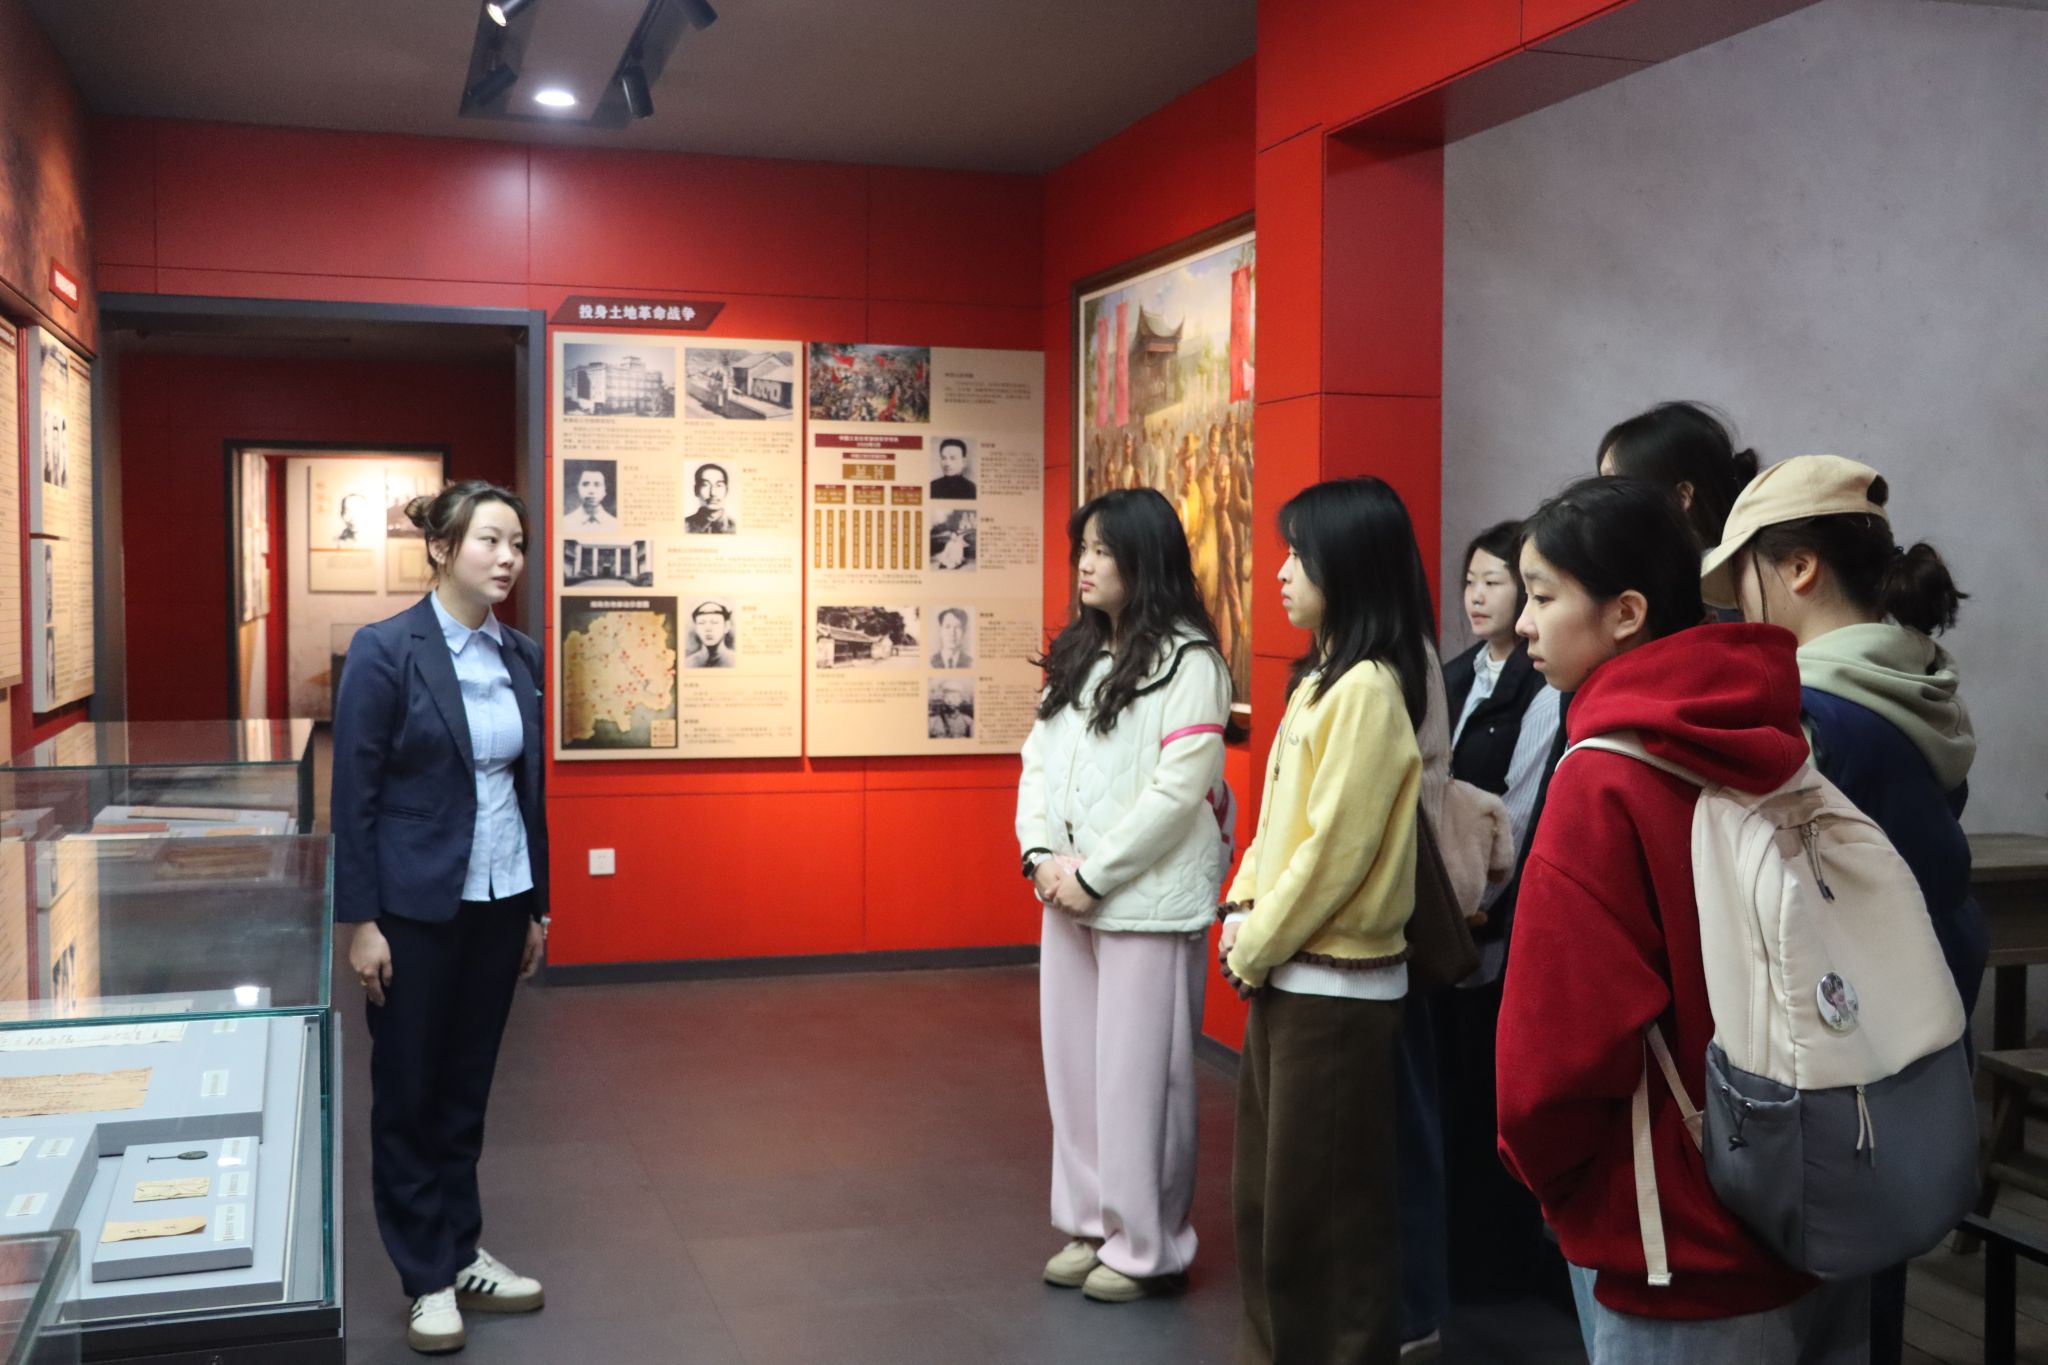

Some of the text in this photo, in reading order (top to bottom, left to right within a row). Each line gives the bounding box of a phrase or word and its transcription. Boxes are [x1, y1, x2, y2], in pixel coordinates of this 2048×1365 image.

[579, 304, 696, 321] 投身土地革命战争
